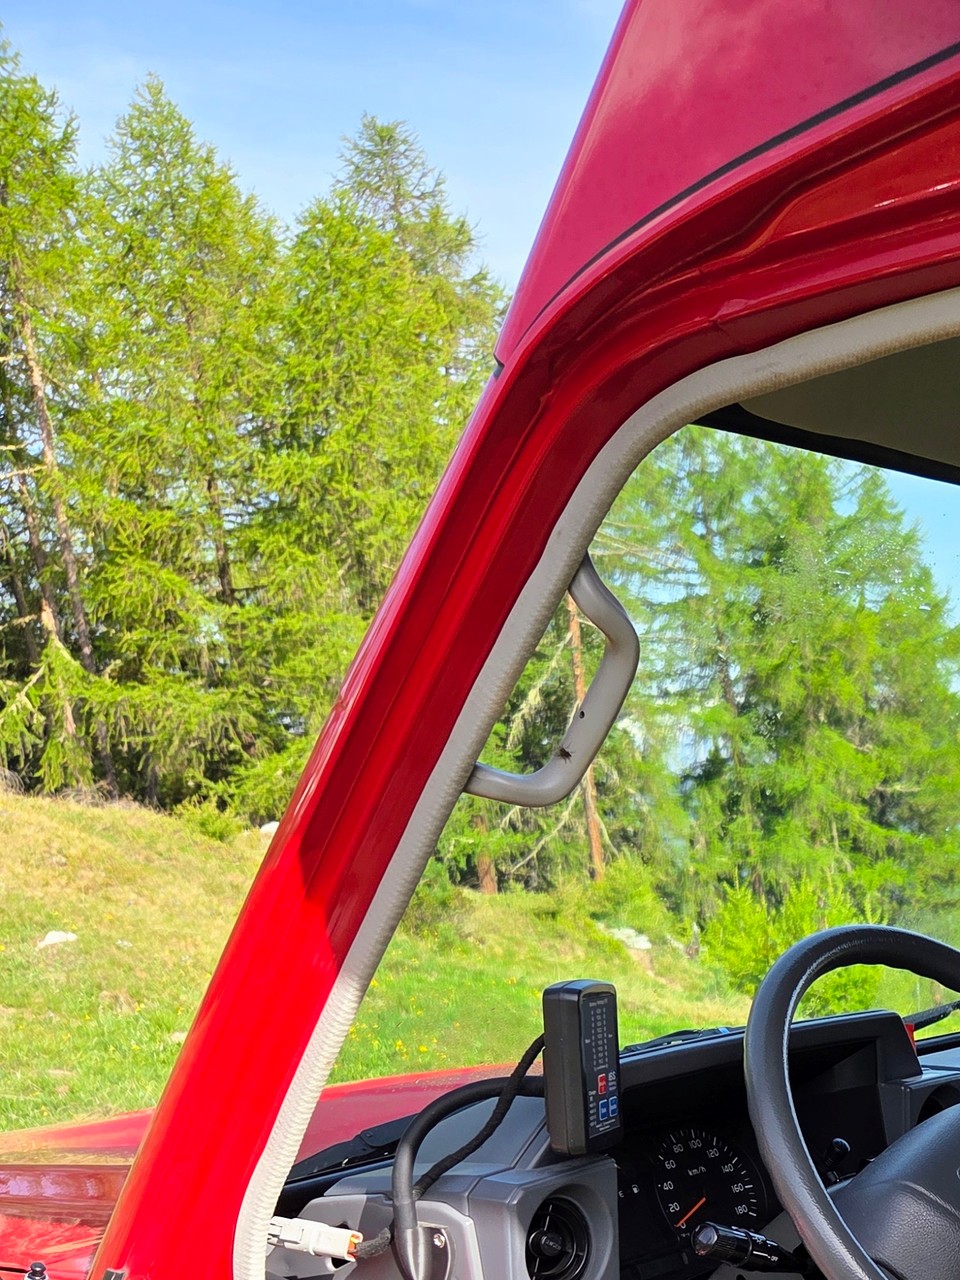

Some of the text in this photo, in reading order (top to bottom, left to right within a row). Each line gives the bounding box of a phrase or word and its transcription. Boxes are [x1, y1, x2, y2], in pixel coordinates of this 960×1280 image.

[673, 1144, 684, 1153] 80
[689, 1139, 702, 1149] 100
[706, 1148, 720, 1158] 120
[665, 1160, 676, 1169] 60
[721, 1164, 734, 1173] 140
[688, 1166, 706, 1176] km/h
[663, 1181, 674, 1191] 40
[731, 1183, 744, 1193] 160
[668, 1202, 680, 1213] 20
[735, 1204, 748, 1215] 180
